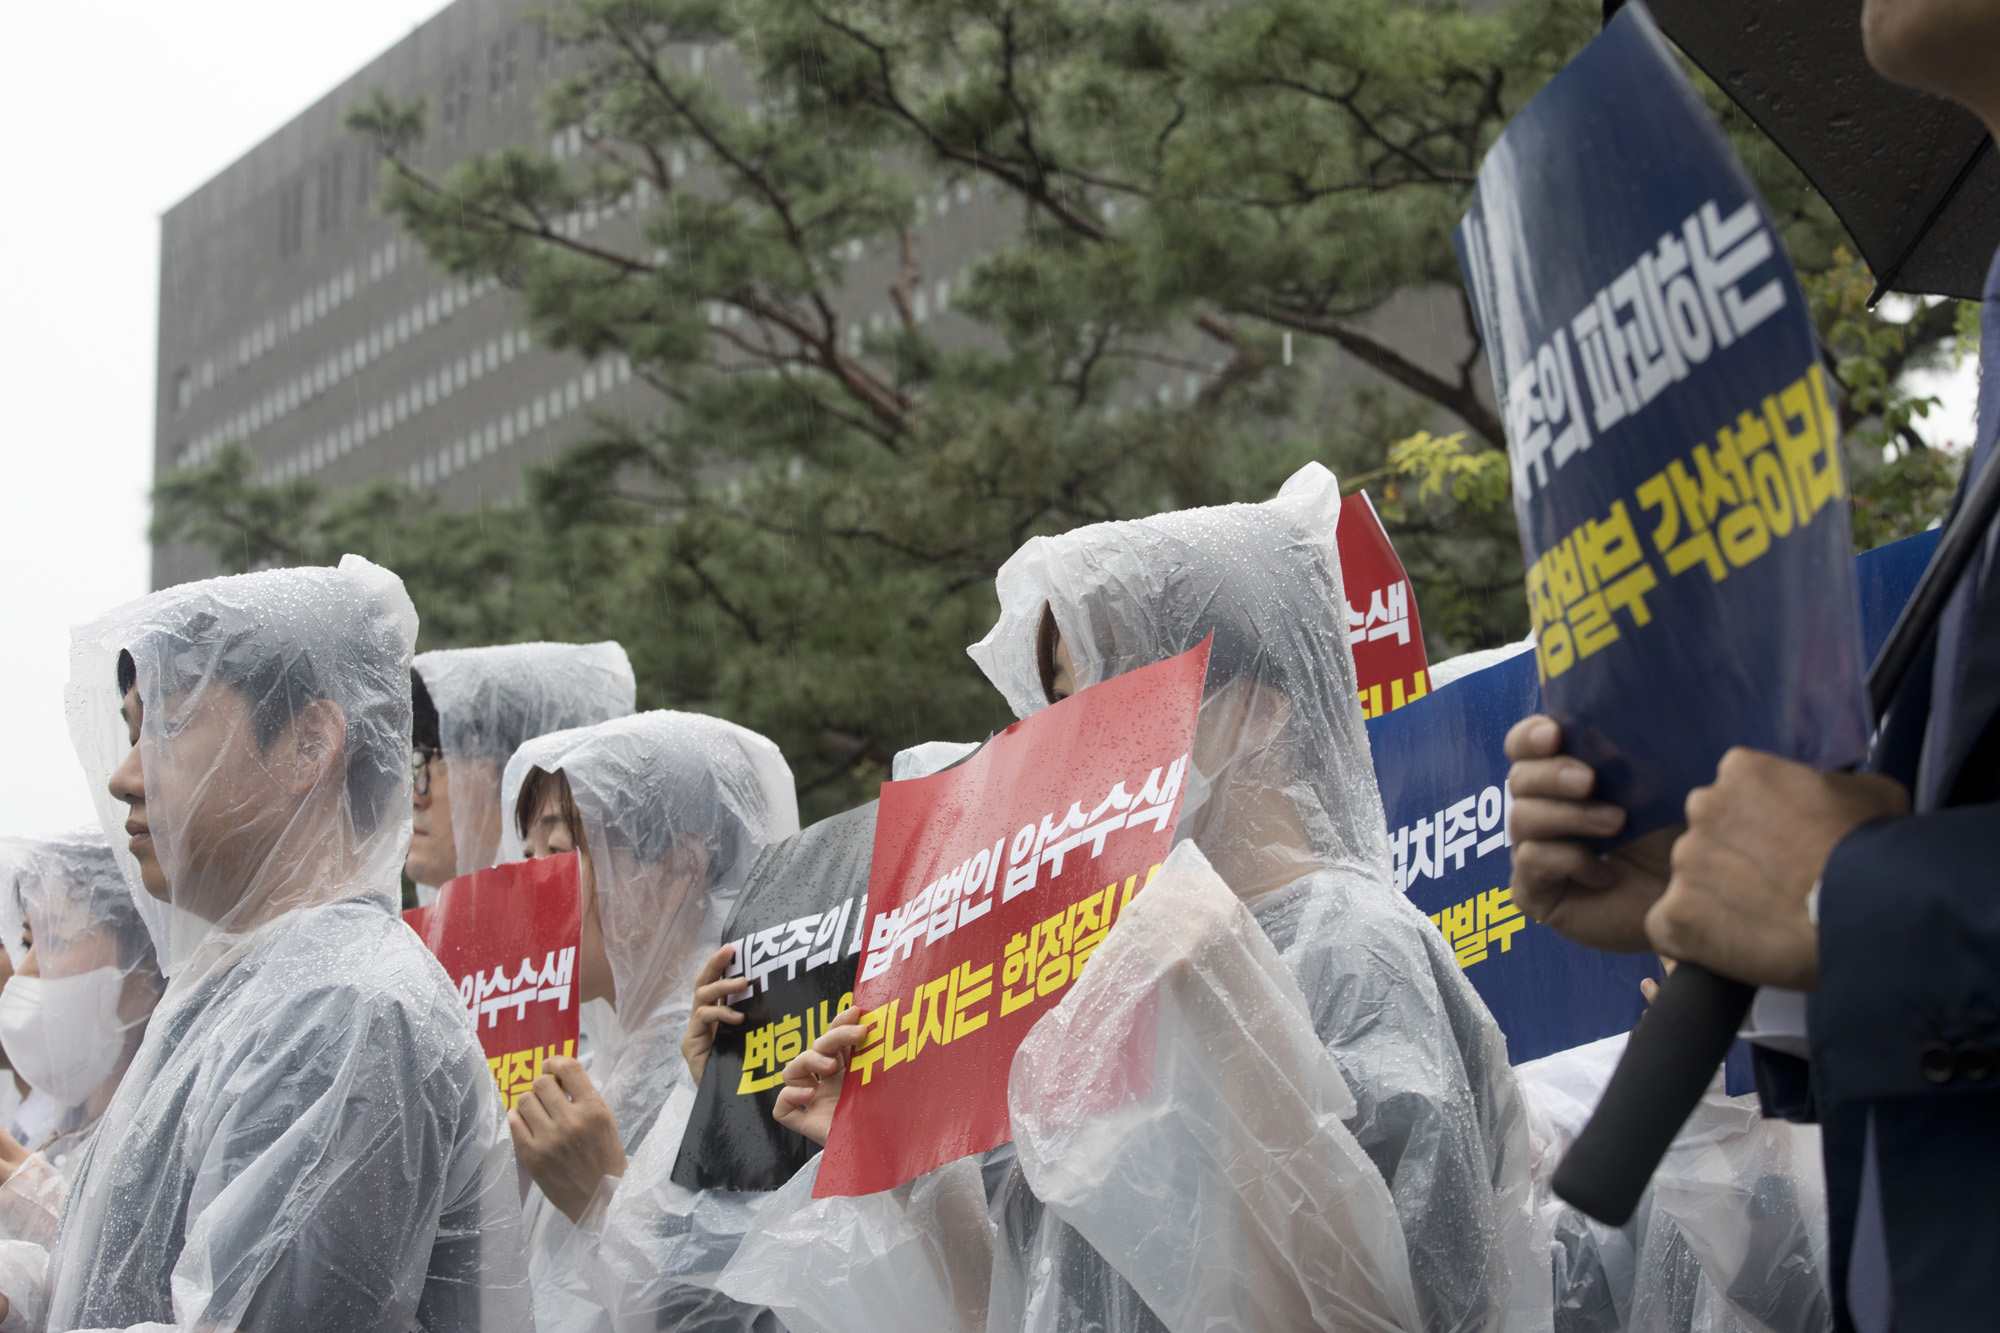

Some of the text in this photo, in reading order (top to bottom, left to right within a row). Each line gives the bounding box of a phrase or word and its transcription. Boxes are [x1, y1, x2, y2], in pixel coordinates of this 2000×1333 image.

[1507, 201, 1785, 498] 주의 파괴하는
[1526, 366, 1844, 683] 장발부 각성하라
[725, 897, 854, 1006] 민주주의
[850, 960, 993, 1085] 무너지는
[1000, 862, 1162, 1018] 헌정질
[860, 837, 1005, 983] 법무법인
[1002, 752, 1189, 904] 압수수색
[1424, 886, 1526, 970] 발부
